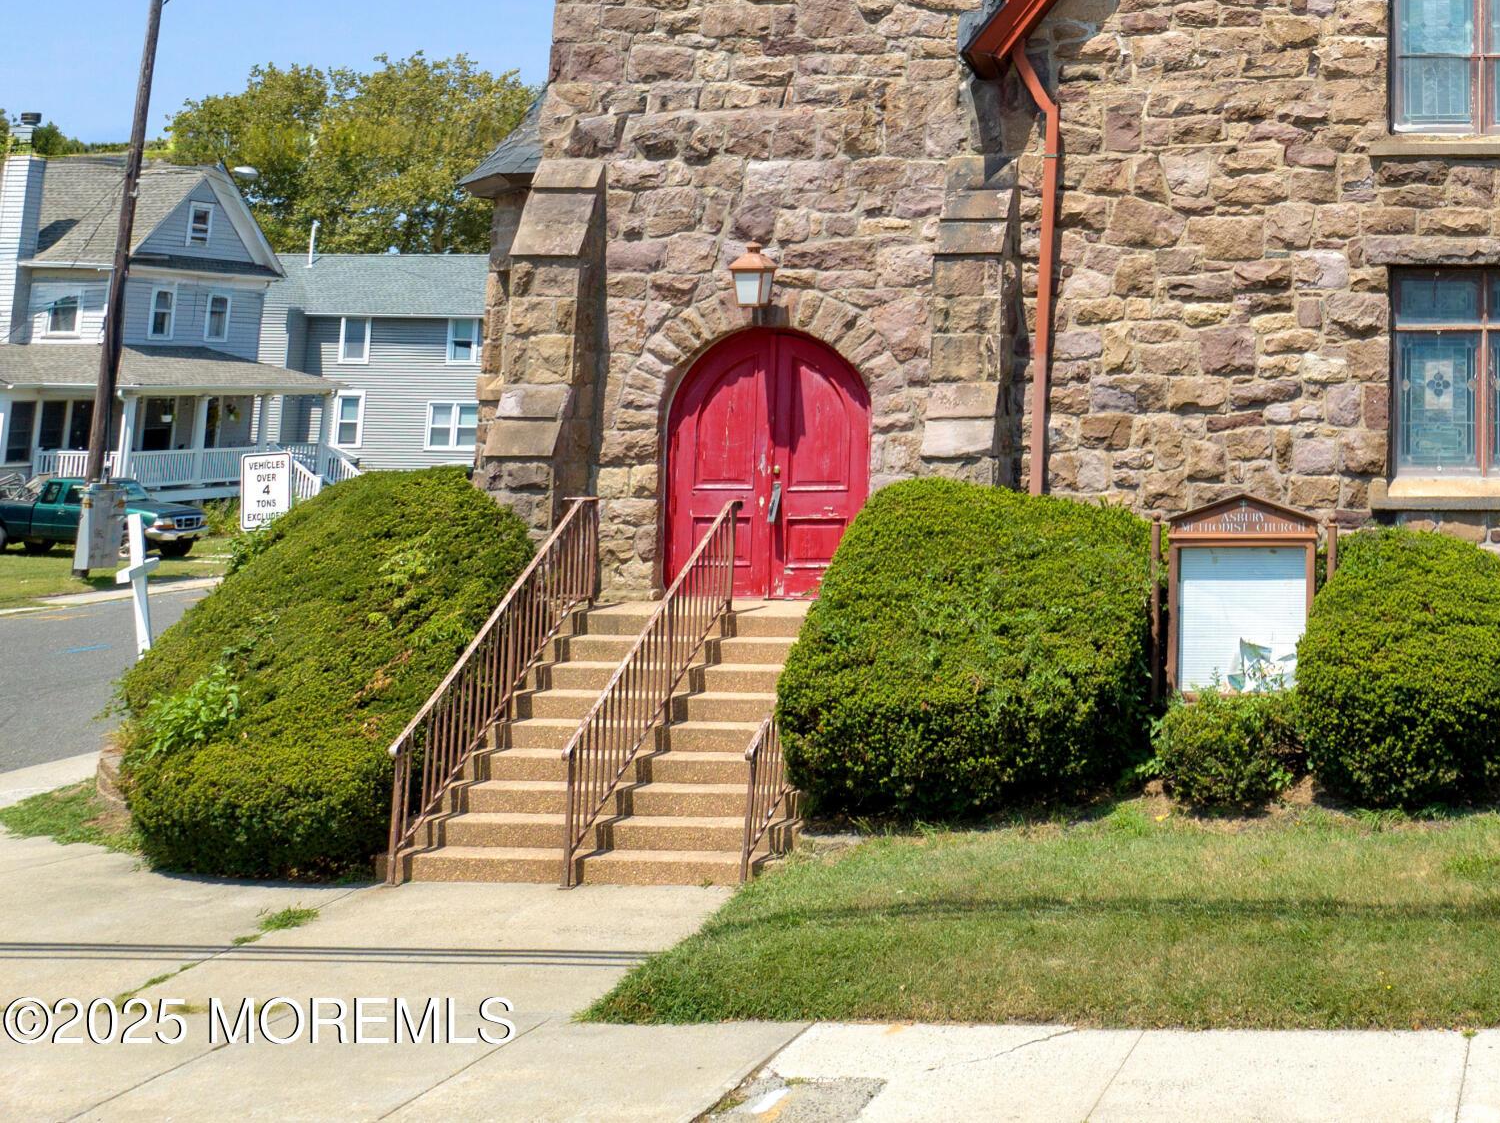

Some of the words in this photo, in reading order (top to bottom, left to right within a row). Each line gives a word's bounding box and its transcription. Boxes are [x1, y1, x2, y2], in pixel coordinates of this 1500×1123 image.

[248, 460, 285, 470] VEHICLES
[256, 473, 277, 482] OVER
[262, 484, 271, 495] 4
[256, 499, 277, 508] TONS
[1221, 512, 1265, 522] ASBURY
[1181, 522, 1247, 533] METHODIST
[1256, 521, 1306, 533] CHURCH
